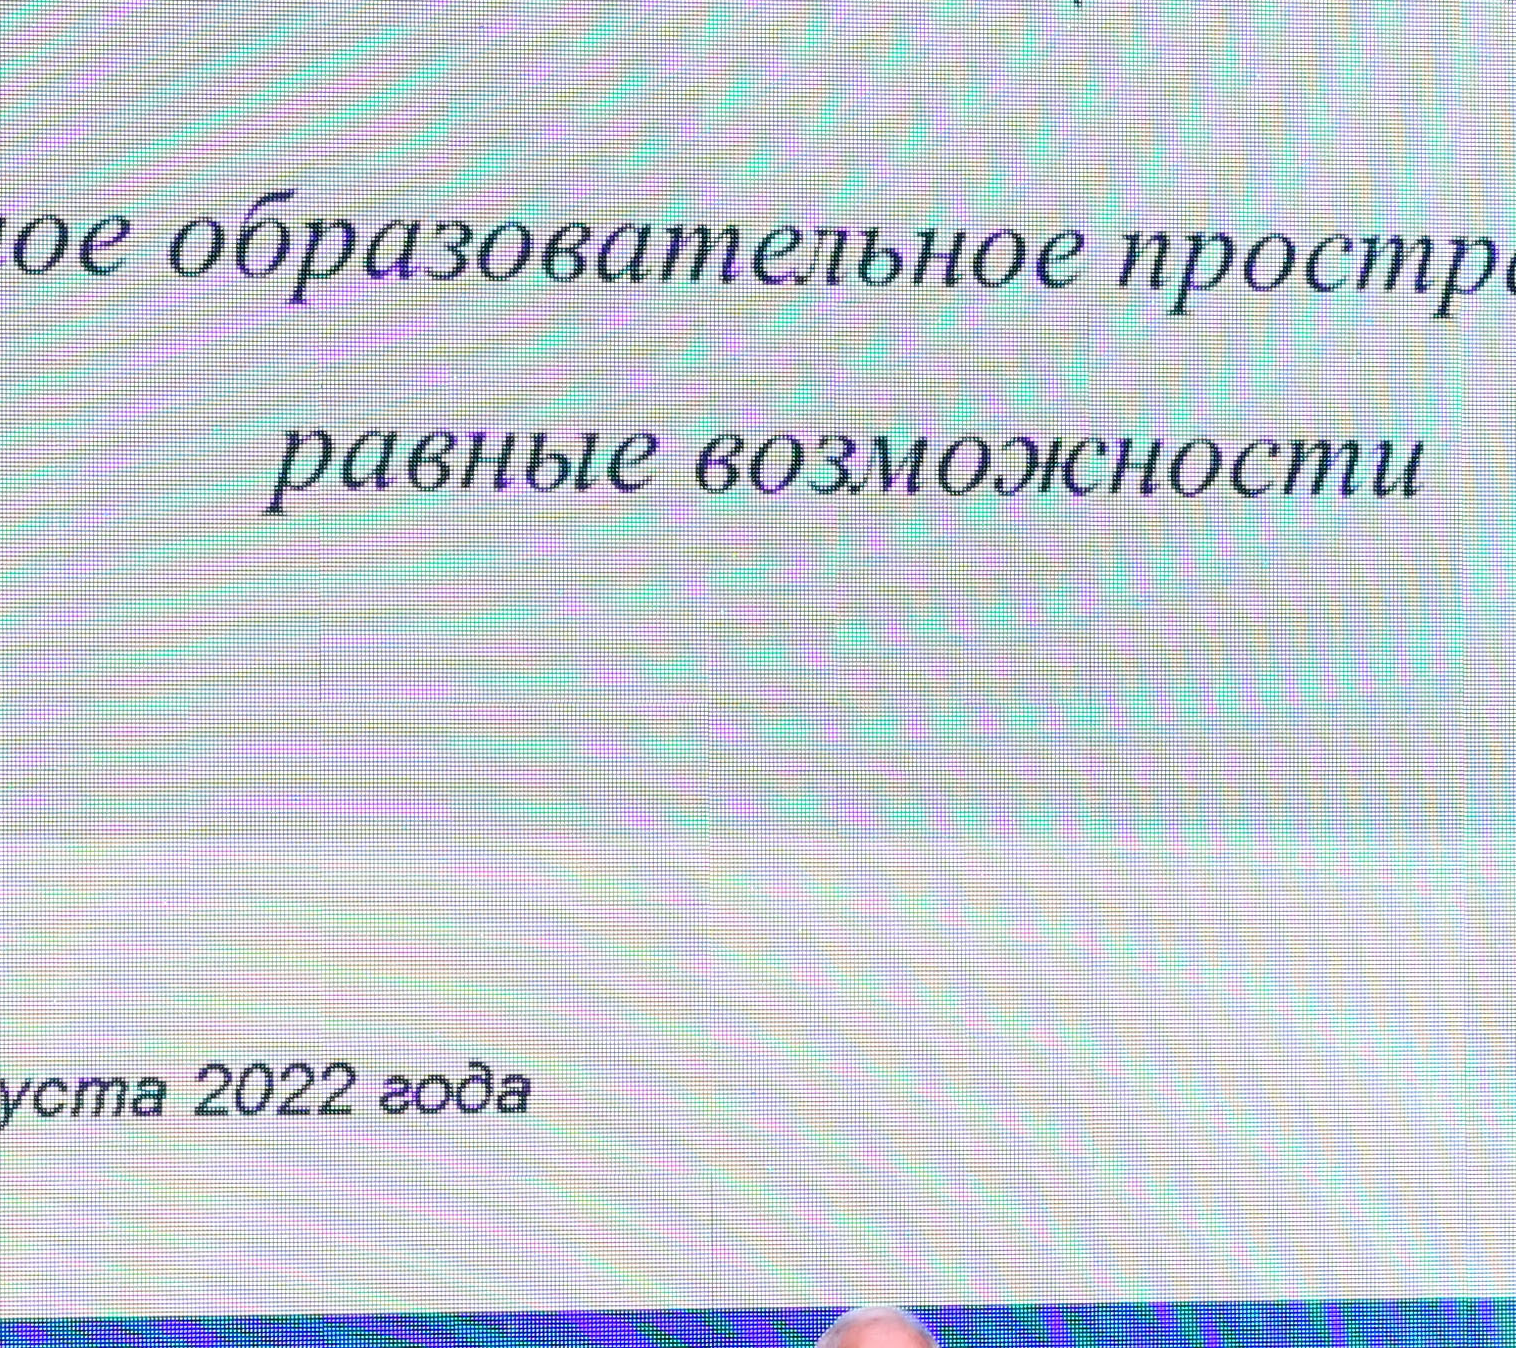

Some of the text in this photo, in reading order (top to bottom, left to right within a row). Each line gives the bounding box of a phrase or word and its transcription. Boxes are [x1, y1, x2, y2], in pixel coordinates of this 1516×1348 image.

[168, 189, 1086, 307] образовательное
[265, 429, 1423, 516] равные возможности
[194, 1060, 358, 1118] 2022
[379, 1060, 532, 1116] года
